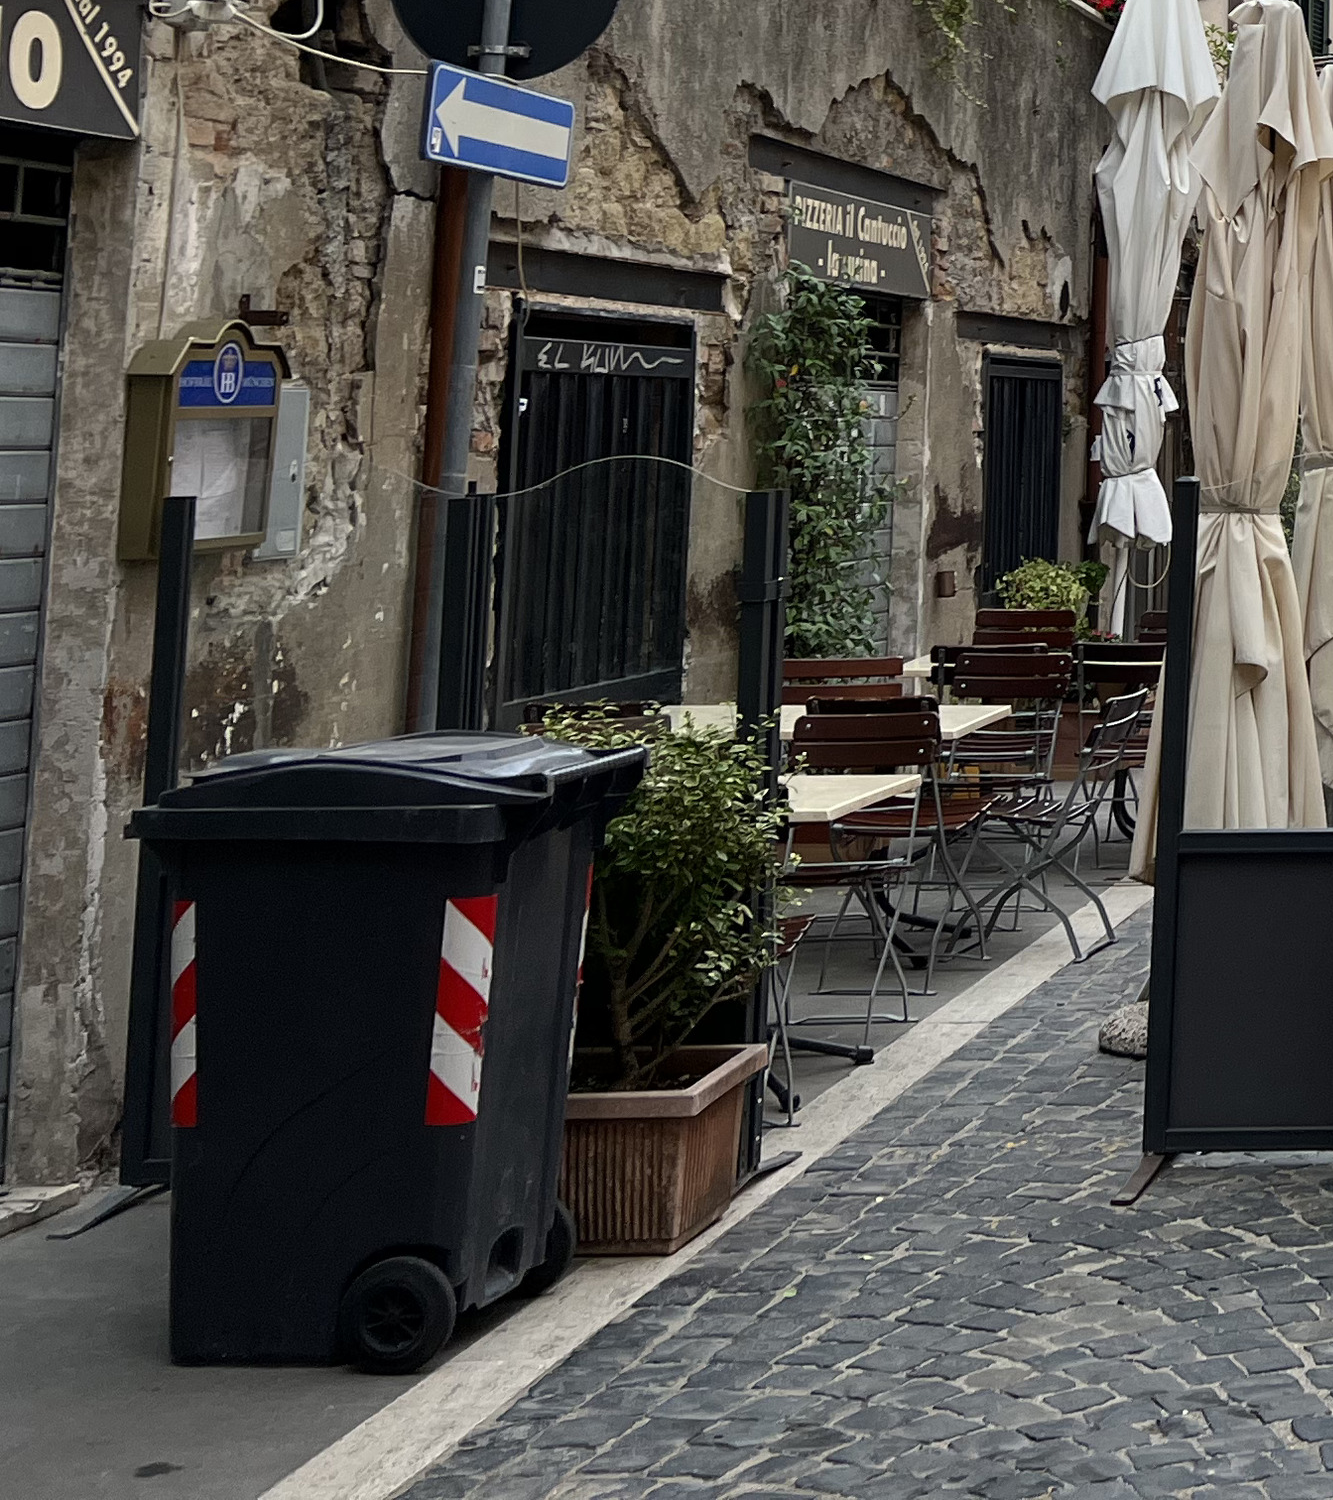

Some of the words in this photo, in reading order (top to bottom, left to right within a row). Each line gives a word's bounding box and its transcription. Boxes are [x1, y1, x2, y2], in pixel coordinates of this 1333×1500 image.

[0, 5, 63, 110] O
[94, 21, 134, 89] 1994
[795, 195, 843, 236] PIZZERIA
[845, 203, 855, 238] il
[857, 206, 908, 250] Cantuccio
